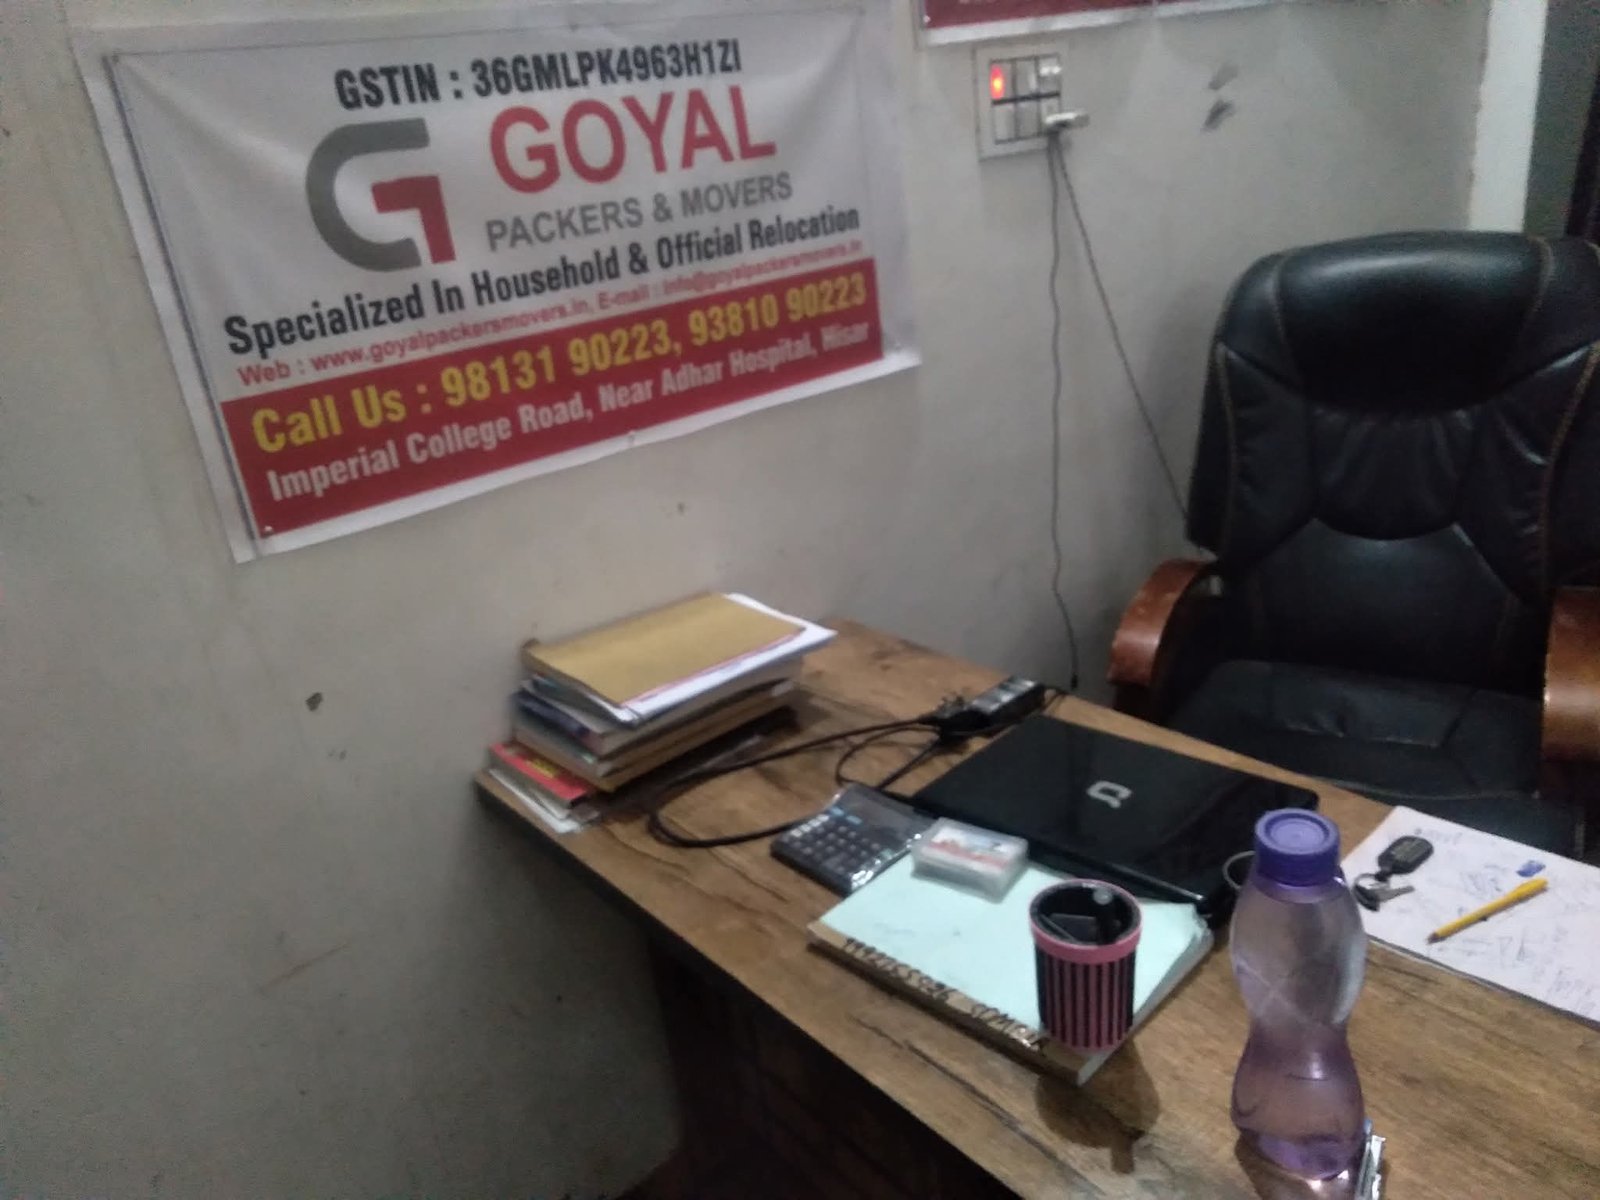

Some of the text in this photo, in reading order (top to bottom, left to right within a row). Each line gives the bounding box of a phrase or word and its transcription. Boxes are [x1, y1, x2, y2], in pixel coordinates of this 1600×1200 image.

[334, 63, 441, 111] GSTIN
[489, 85, 777, 194] GOYAL
[485, 171, 794, 251] PACKERS & MOVERS
[224, 205, 861, 360] Specialized In Household & Official Relocation
[237, 359, 292, 387] Web
[252, 395, 343, 453] Call
[351, 384, 407, 428] Us
[441, 345, 556, 408] 98131
[568, 319, 682, 377] 90223,
[688, 293, 779, 346] 93810
[785, 271, 868, 322] 90223
[267, 439, 401, 501] Imperial
[407, 416, 523, 465] College
[517, 391, 594, 434] Road,
[598, 379, 654, 413] Near
